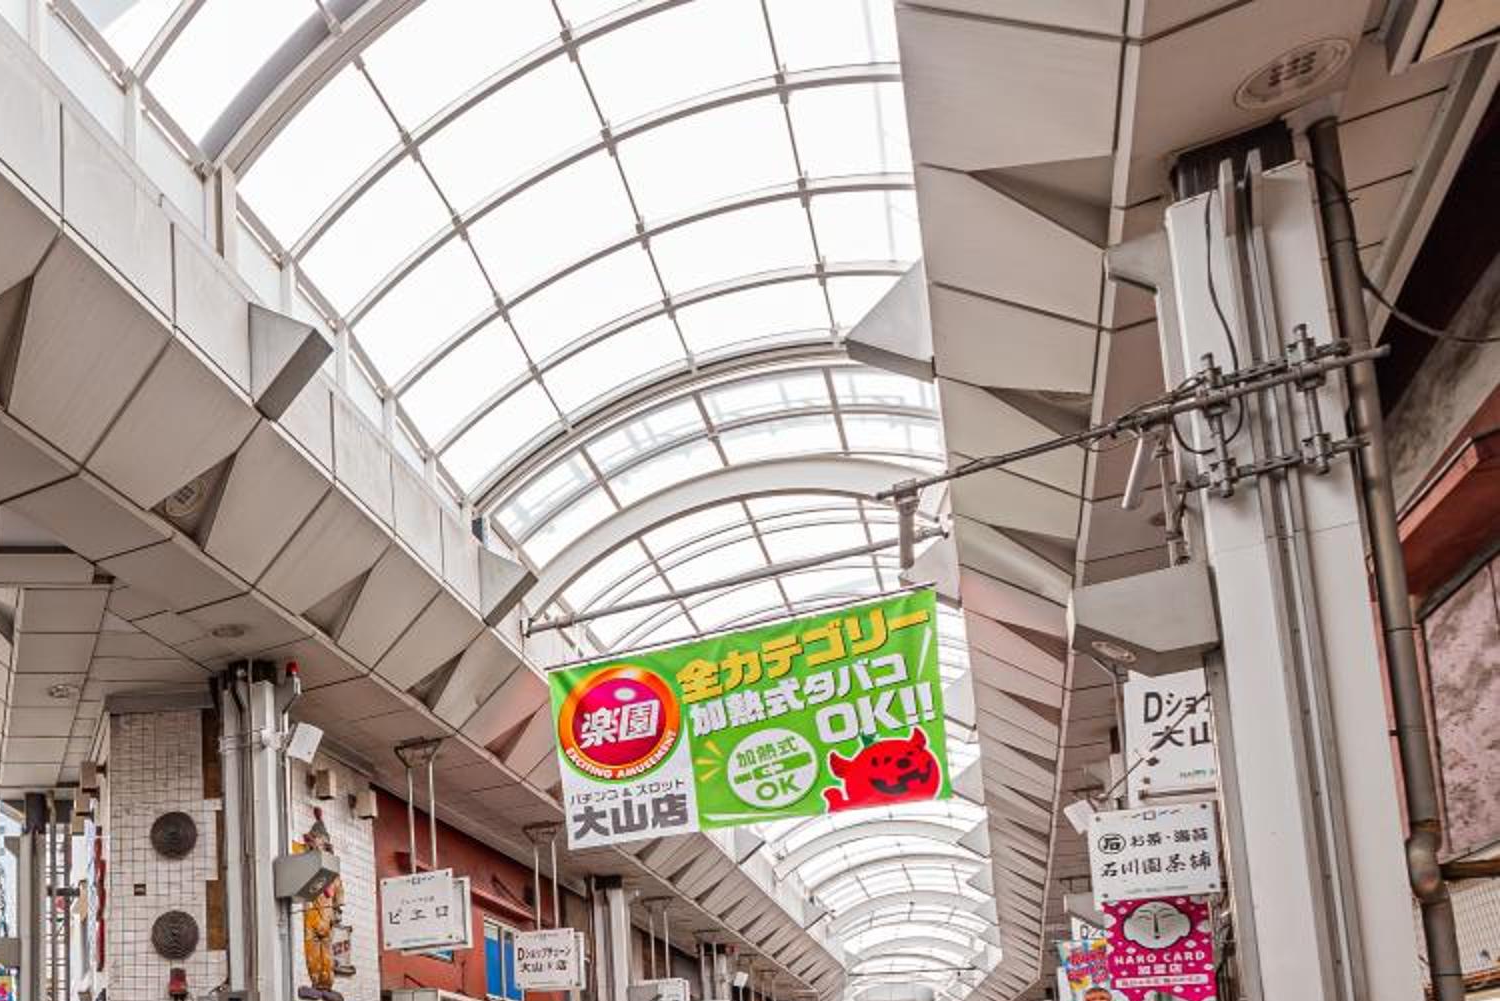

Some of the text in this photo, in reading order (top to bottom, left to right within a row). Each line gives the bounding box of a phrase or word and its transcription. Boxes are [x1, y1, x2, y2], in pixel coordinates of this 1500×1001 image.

[676, 608, 930, 704] 全カテゴリー
[690, 653, 909, 737] 加熱式タバコ
[815, 682, 935, 744] OK!!
[579, 698, 660, 749] 楽園
[565, 729, 677, 779] EXCITING AMUSEMENT
[736, 735, 799, 768] 加熱式
[755, 774, 801, 801] OK
[572, 793, 688, 840] 大山店
[388, 905, 449, 924] ピエロ
[1163, 950, 1205, 963] CARD
